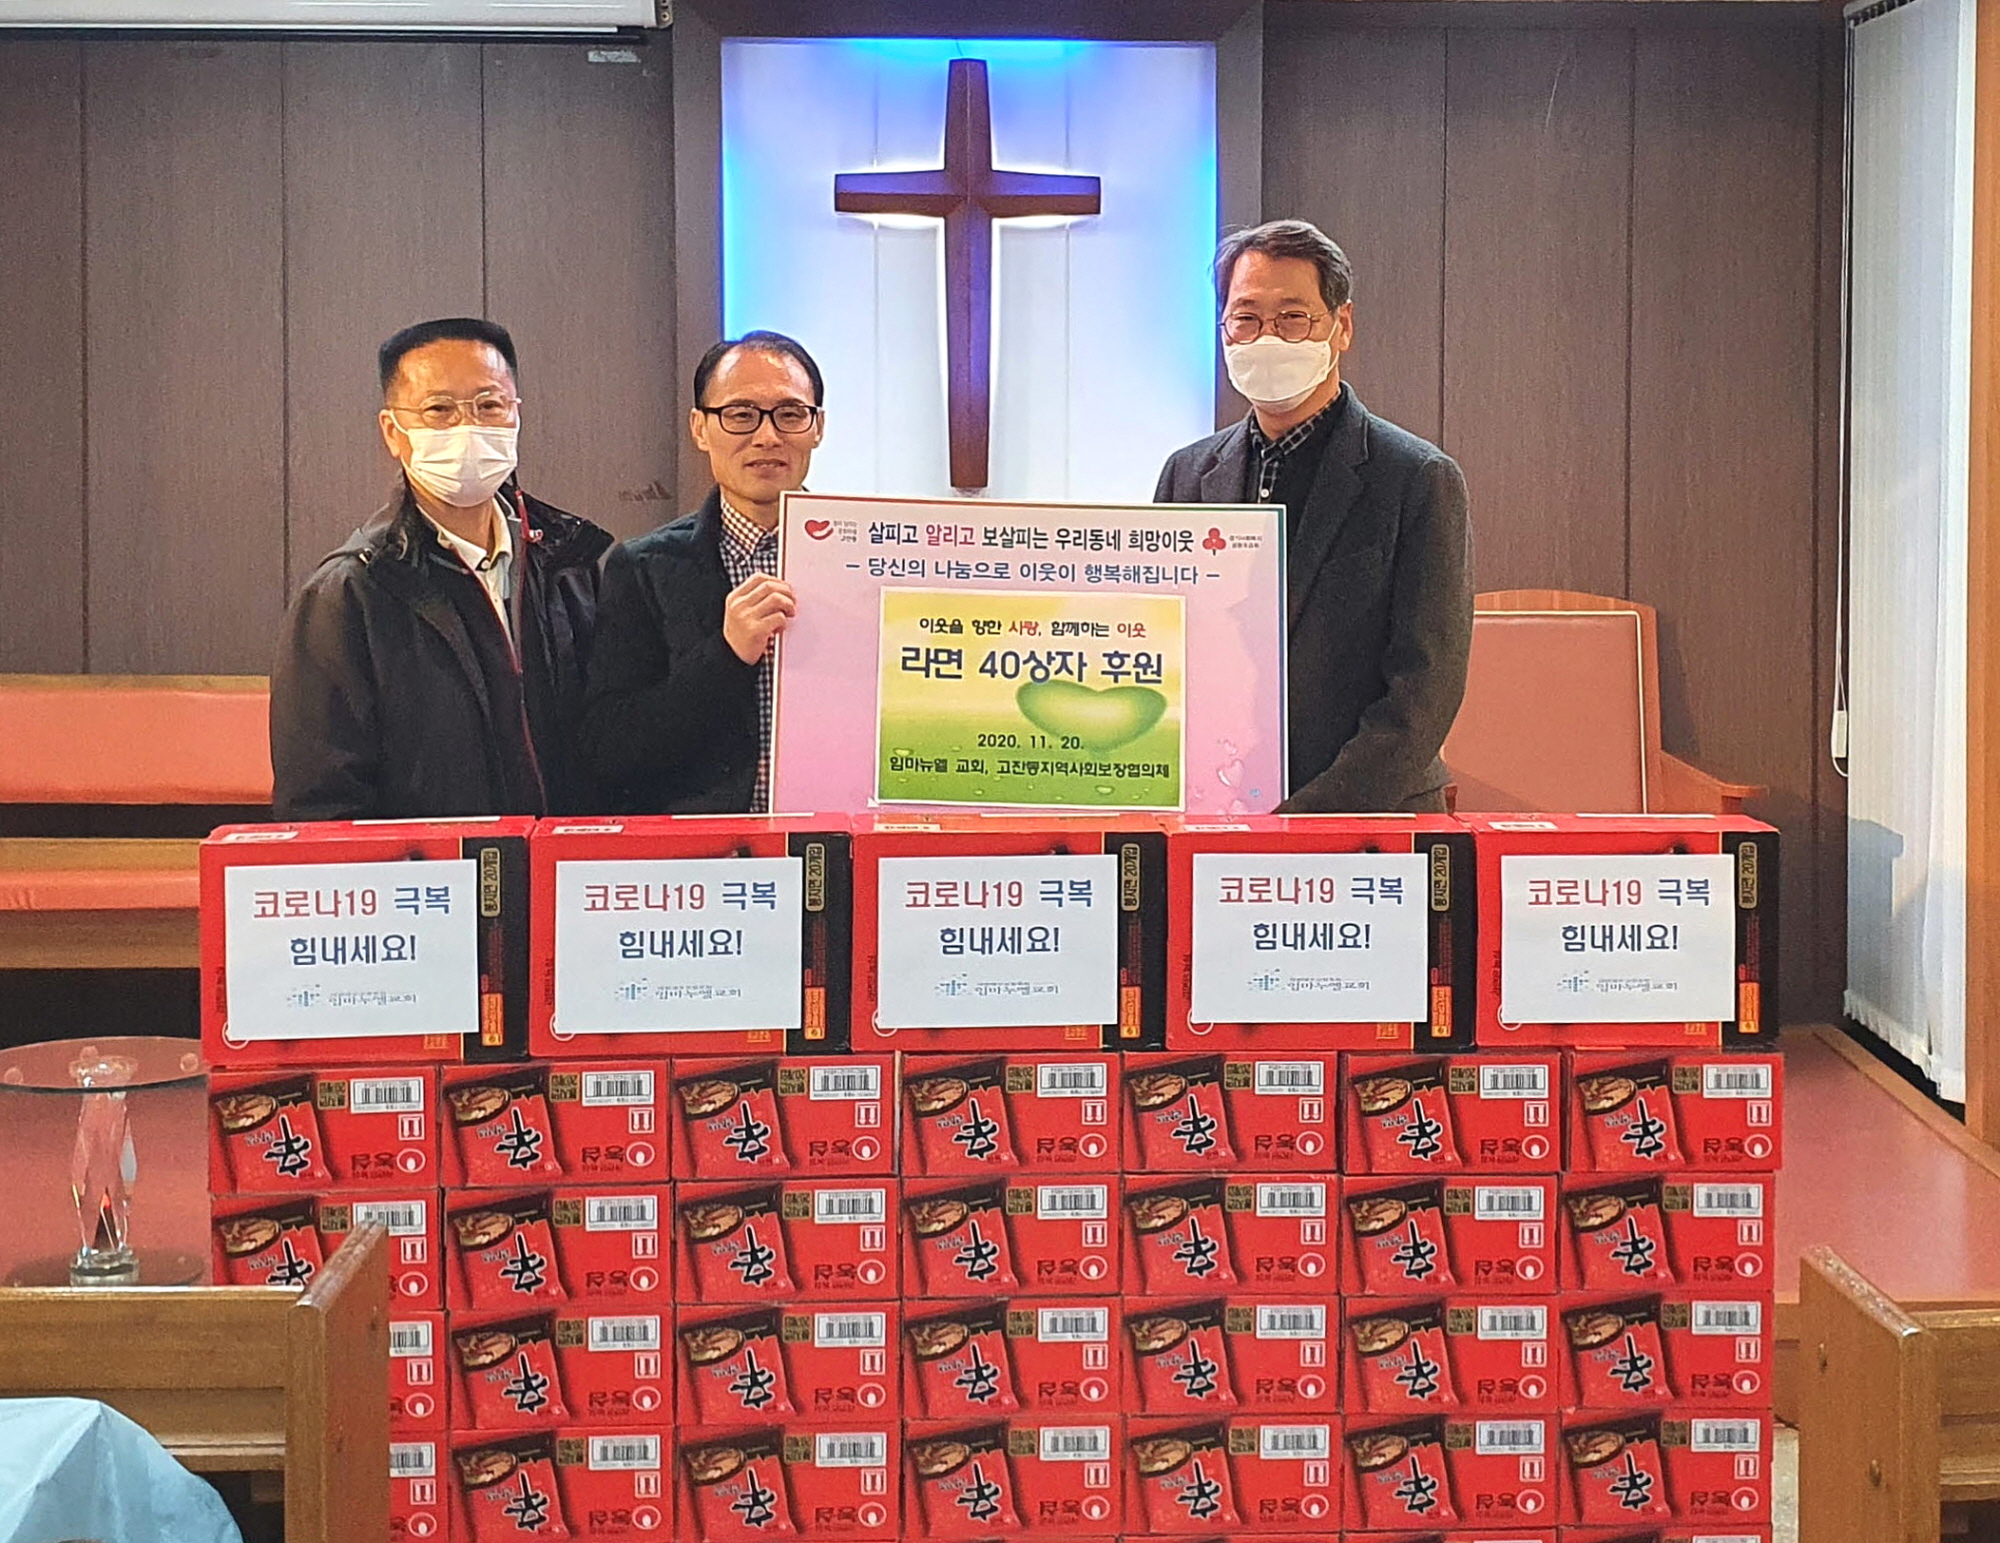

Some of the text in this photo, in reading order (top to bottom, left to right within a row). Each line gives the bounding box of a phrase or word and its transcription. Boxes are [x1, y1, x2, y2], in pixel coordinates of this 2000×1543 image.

[868, 521, 919, 545] 살피고
[926, 524, 976, 547] 알리고
[982, 526, 1049, 550] 보살피는
[1055, 527, 1121, 552] 우리동네
[1128, 529, 1194, 553] 희망이웃
[868, 557, 1199, 585] 당신의 나눔으로 이웃이 행복해집니다
[920, 618, 1147, 638] 이웃을 향한 사랑, 함께하는 이웃
[901, 647, 1162, 684] 라면 40상자 후원
[956, 759, 989, 775] 교회,
[977, 734, 1084, 750] 2020. 11. 20.
[253, 886, 451, 919] 코로나19 극복
[583, 881, 778, 912] 코로나19 극복
[905, 879, 1093, 909] 코로나19 극복
[1219, 877, 1404, 905] 코로나19 극복
[1528, 878, 1710, 907] 코로나19 극복
[290, 934, 416, 966] 힘내세요!
[619, 929, 743, 959] 힘내세요!
[940, 926, 1060, 956] 힘내세요!
[1253, 922, 1371, 951] 힘내세요!
[1561, 924, 1679, 953] 힘내세요!
[263, 1114, 311, 1176] 辛
[494, 1107, 542, 1169] 辛
[724, 1100, 769, 1161] 辛
[953, 1097, 998, 1158] 辛
[1171, 1093, 1216, 1154] 辛
[1397, 1098, 1442, 1159] 辛
[1620, 1097, 1665, 1158] 辛
[498, 1232, 546, 1294] 辛
[953, 1219, 998, 1280] 辛
[1172, 1215, 1217, 1276] 辛
[1391, 1218, 1436, 1279] 辛
[1610, 1214, 1655, 1275] 辛
[501, 1351, 549, 1413] 辛
[729, 1347, 774, 1408] 辛
[954, 1341, 999, 1402] 辛
[1172, 1337, 1217, 1398] 辛
[1394, 1338, 1439, 1399] 辛
[1608, 1332, 1653, 1393] 辛
[502, 1470, 550, 1532] 辛
[730, 1466, 775, 1527] 辛
[955, 1460, 1000, 1521] 辛
[1176, 1458, 1221, 1519] 辛
[1393, 1453, 1438, 1514] 辛
[1607, 1449, 1652, 1510] 辛
